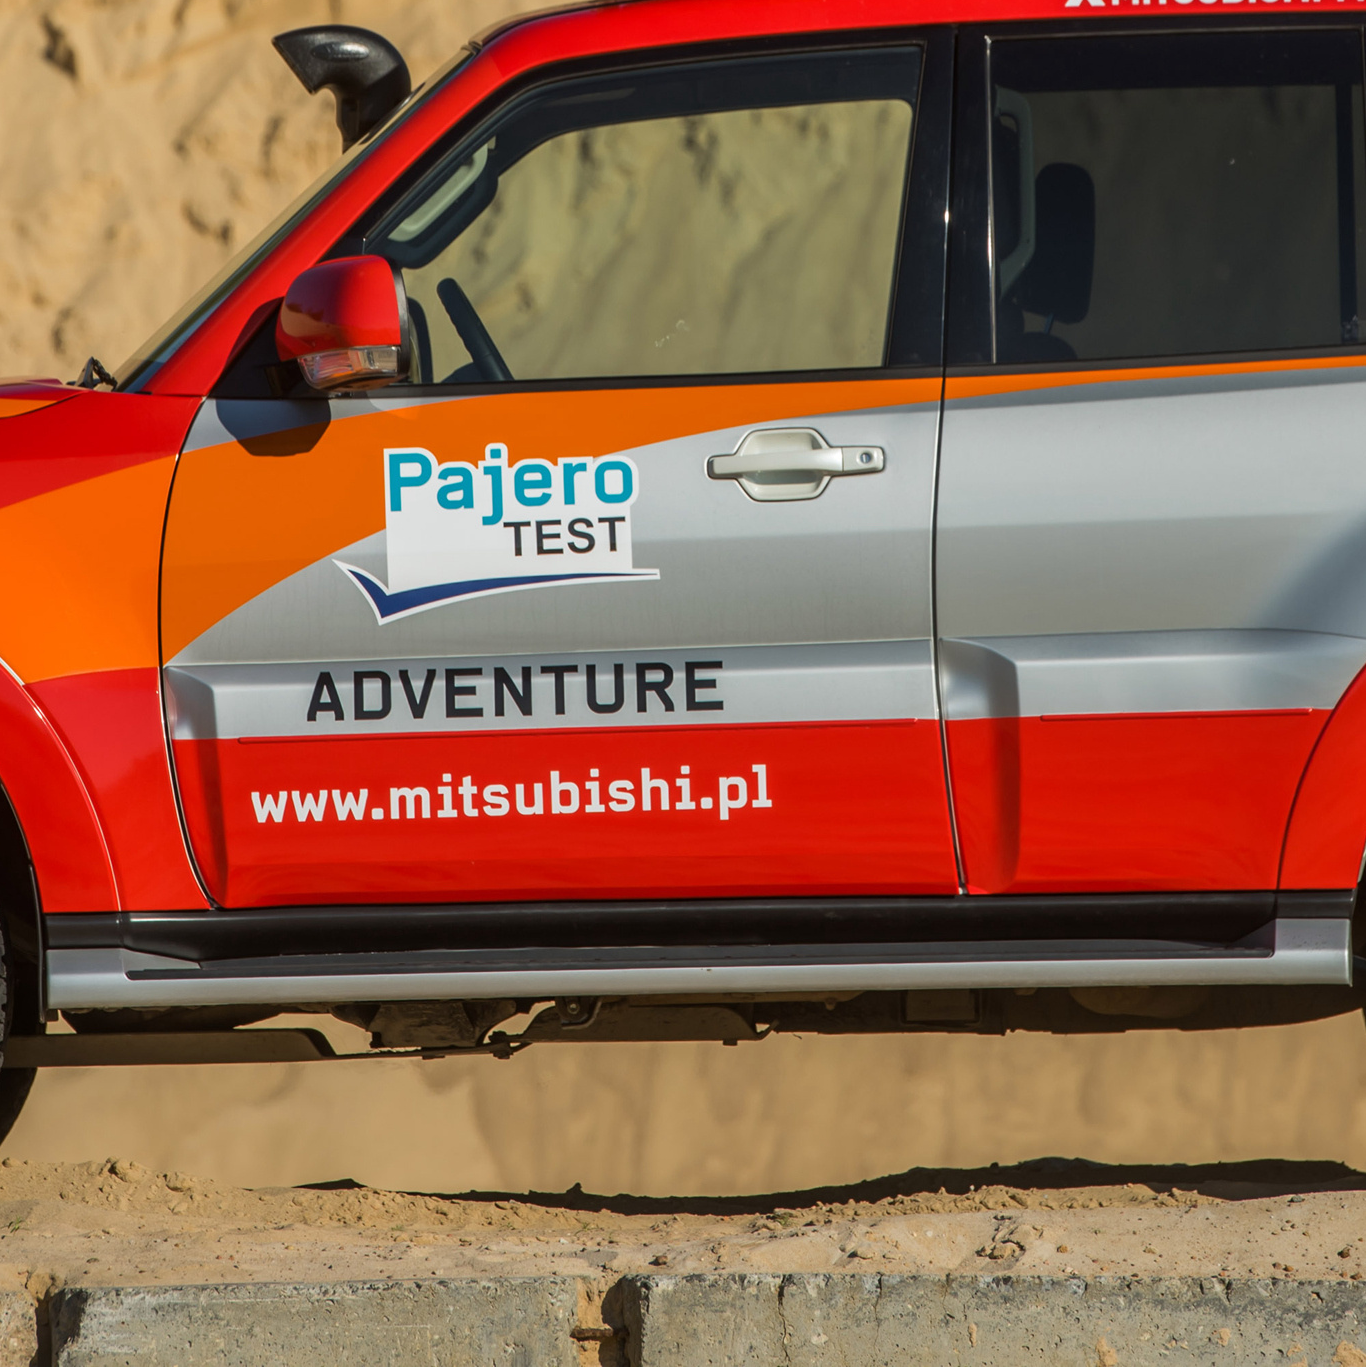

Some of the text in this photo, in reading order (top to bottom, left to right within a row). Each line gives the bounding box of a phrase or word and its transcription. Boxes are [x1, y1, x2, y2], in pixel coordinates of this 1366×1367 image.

[388, 448, 634, 526] Pajero
[503, 516, 626, 557] TEST
[307, 660, 724, 722] ADVENTURE
[251, 764, 773, 824] www.mitsubishi.pl
